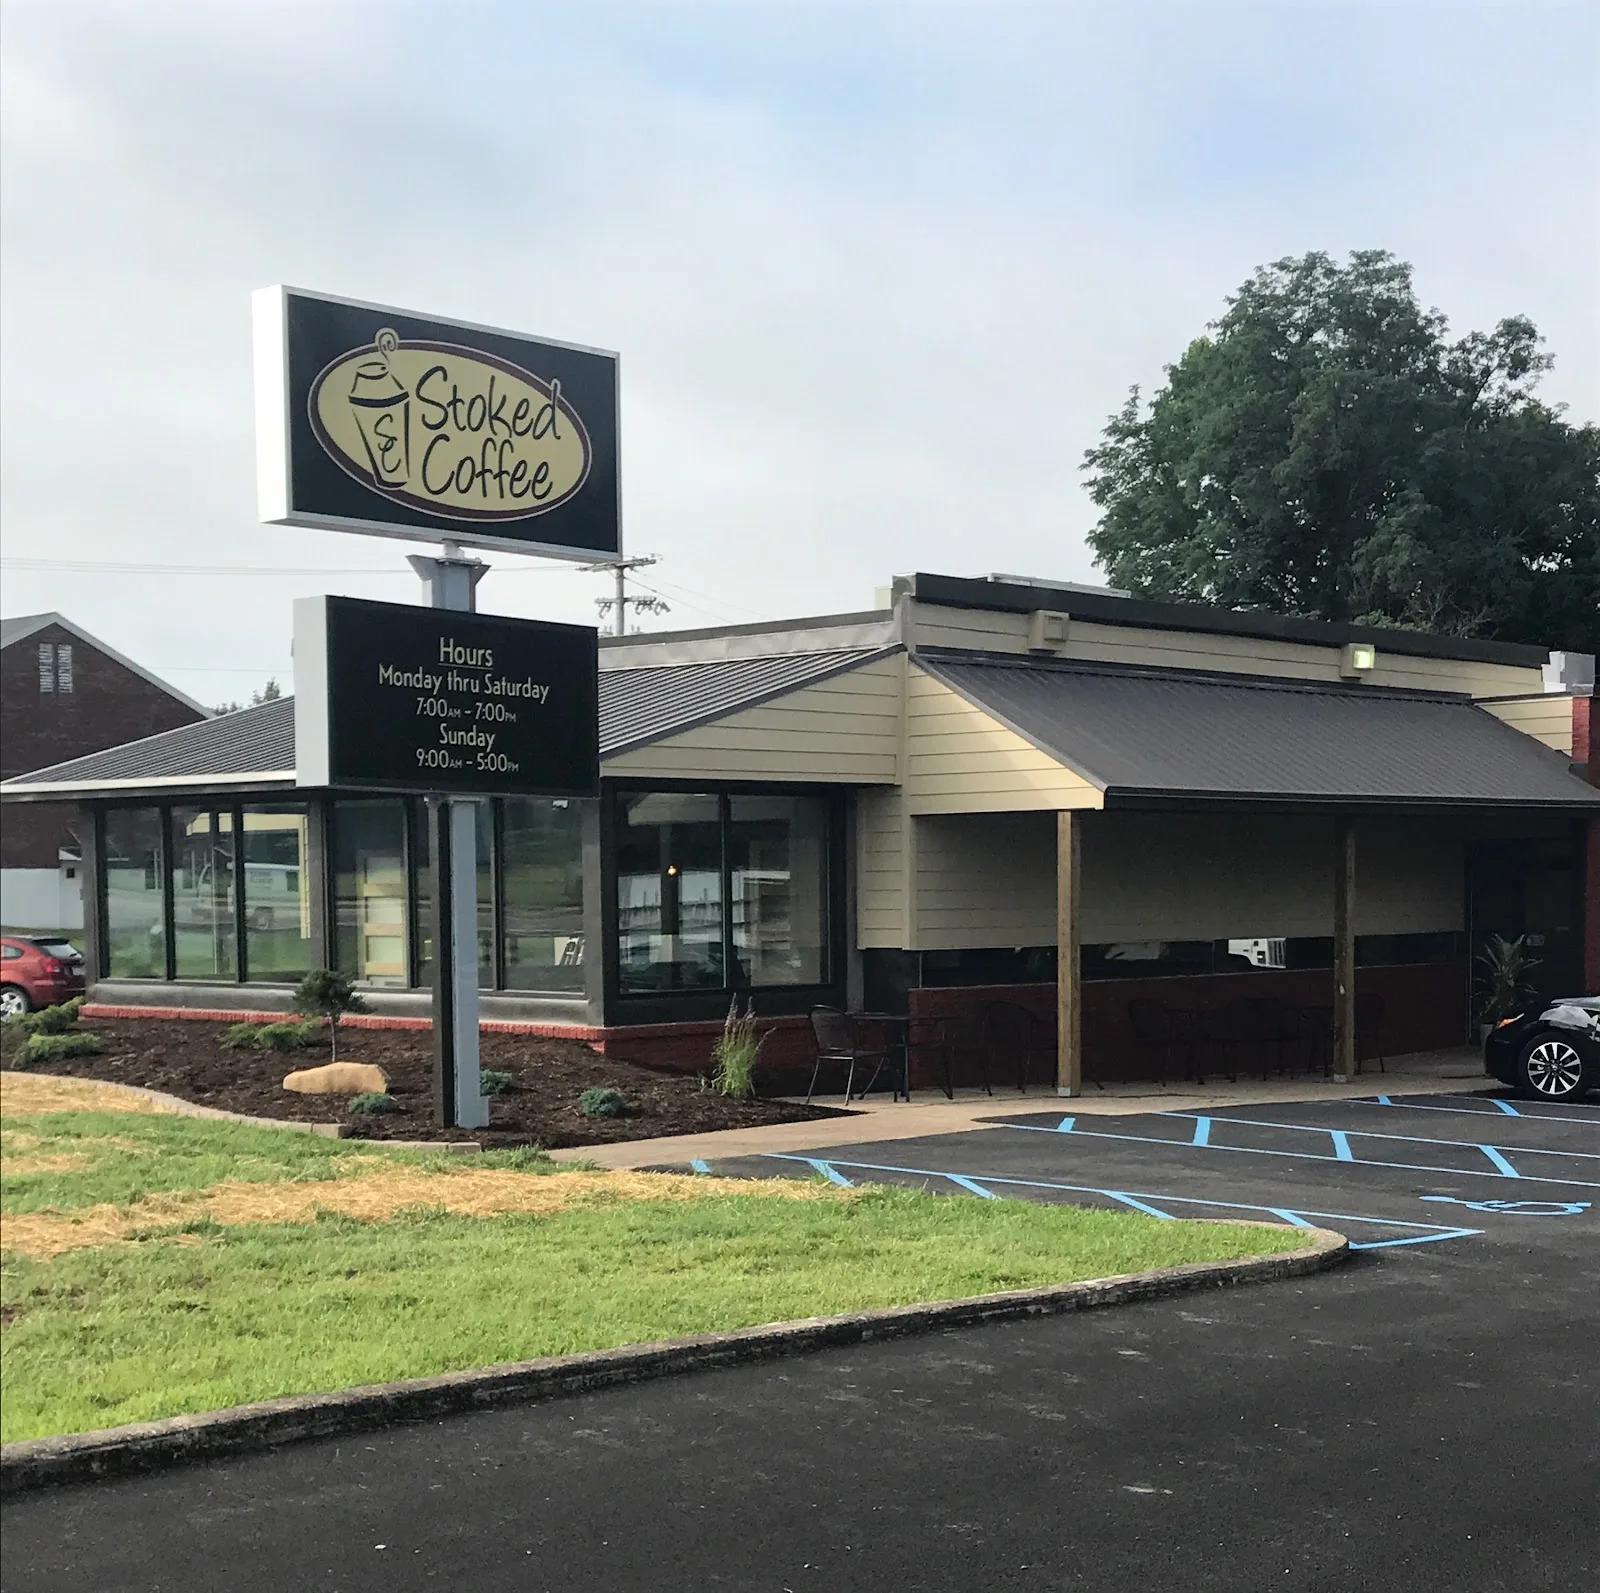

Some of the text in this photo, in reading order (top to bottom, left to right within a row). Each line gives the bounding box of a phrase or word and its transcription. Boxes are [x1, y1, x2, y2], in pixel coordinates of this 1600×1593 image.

[416, 366, 562, 441] Stoked
[421, 434, 553, 500] Coffee
[439, 637, 493, 668] Hours
[378, 663, 549, 705] Monday thru Saturday
[439, 723, 496, 753] Sunday
